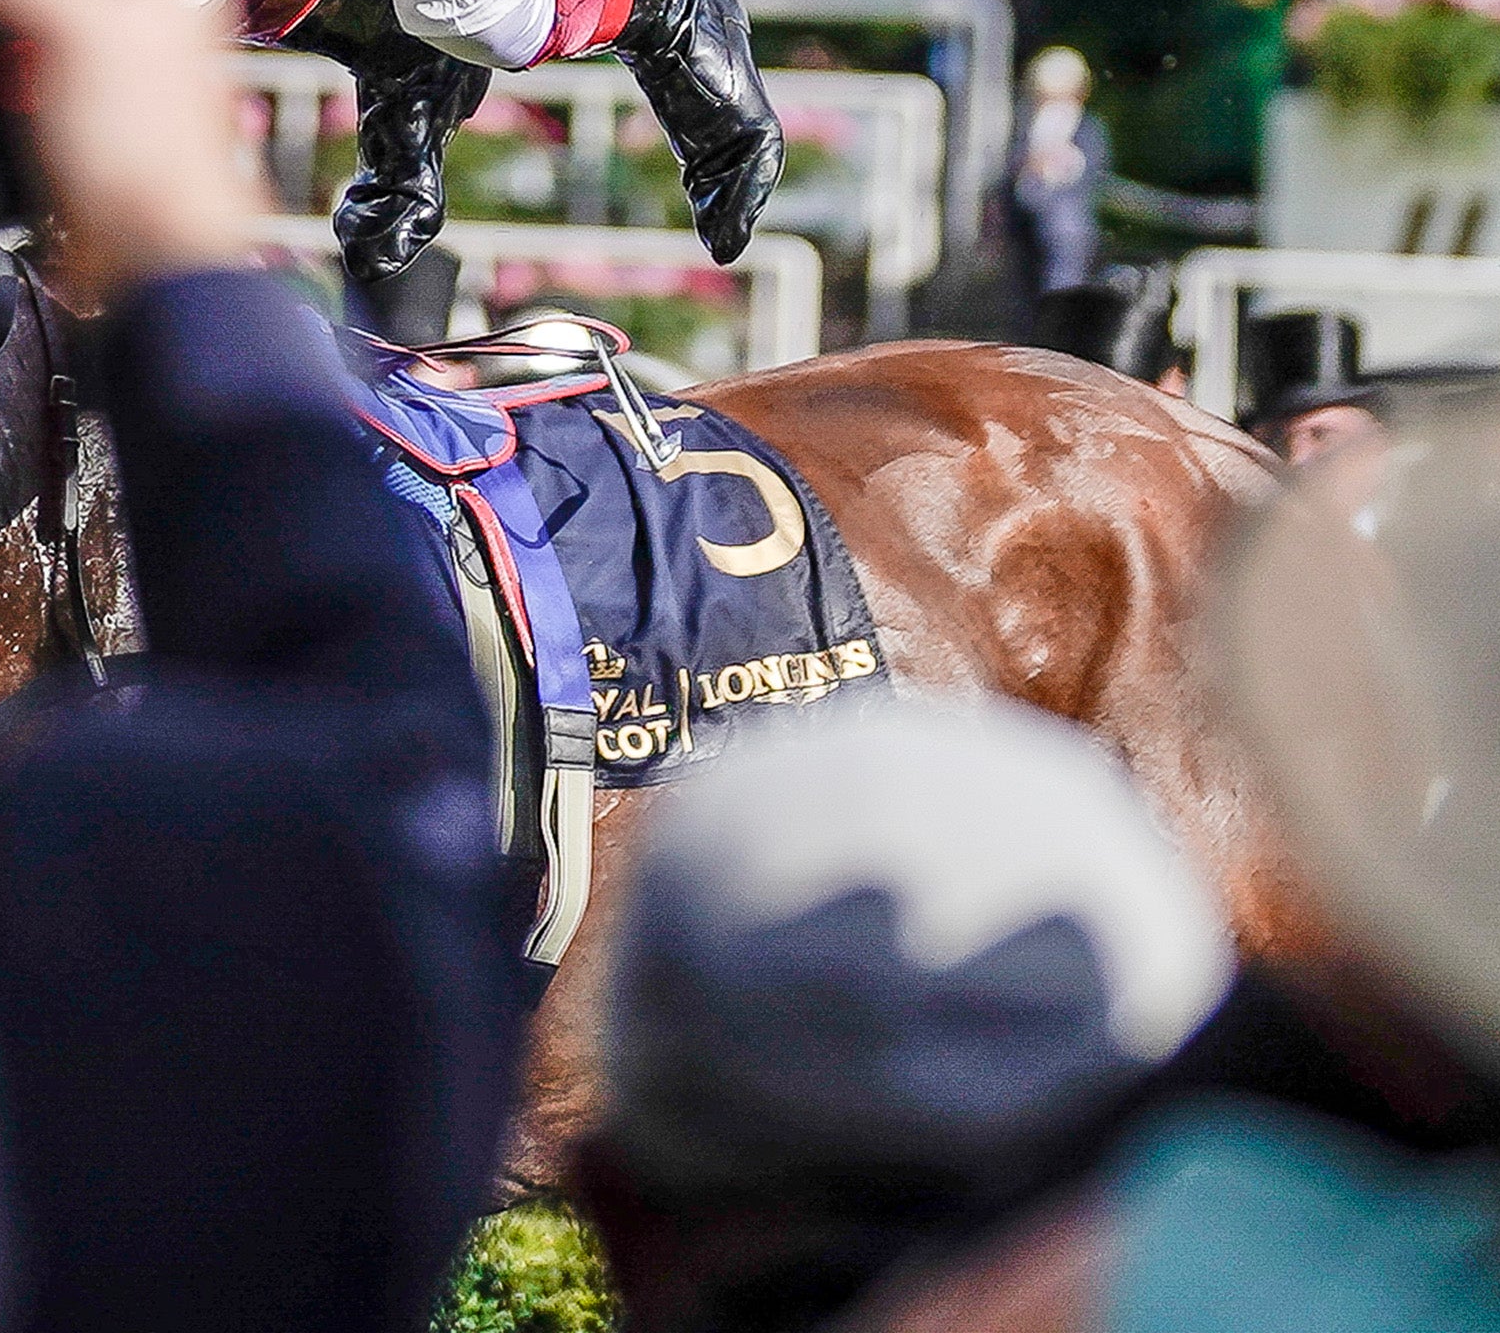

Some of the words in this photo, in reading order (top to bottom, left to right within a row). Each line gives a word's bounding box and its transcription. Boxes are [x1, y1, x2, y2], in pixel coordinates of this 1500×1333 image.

[592, 399, 806, 579] 5
[697, 638, 878, 709] LONGINS
[591, 683, 668, 722] YAL
[596, 719, 672, 761] COT
